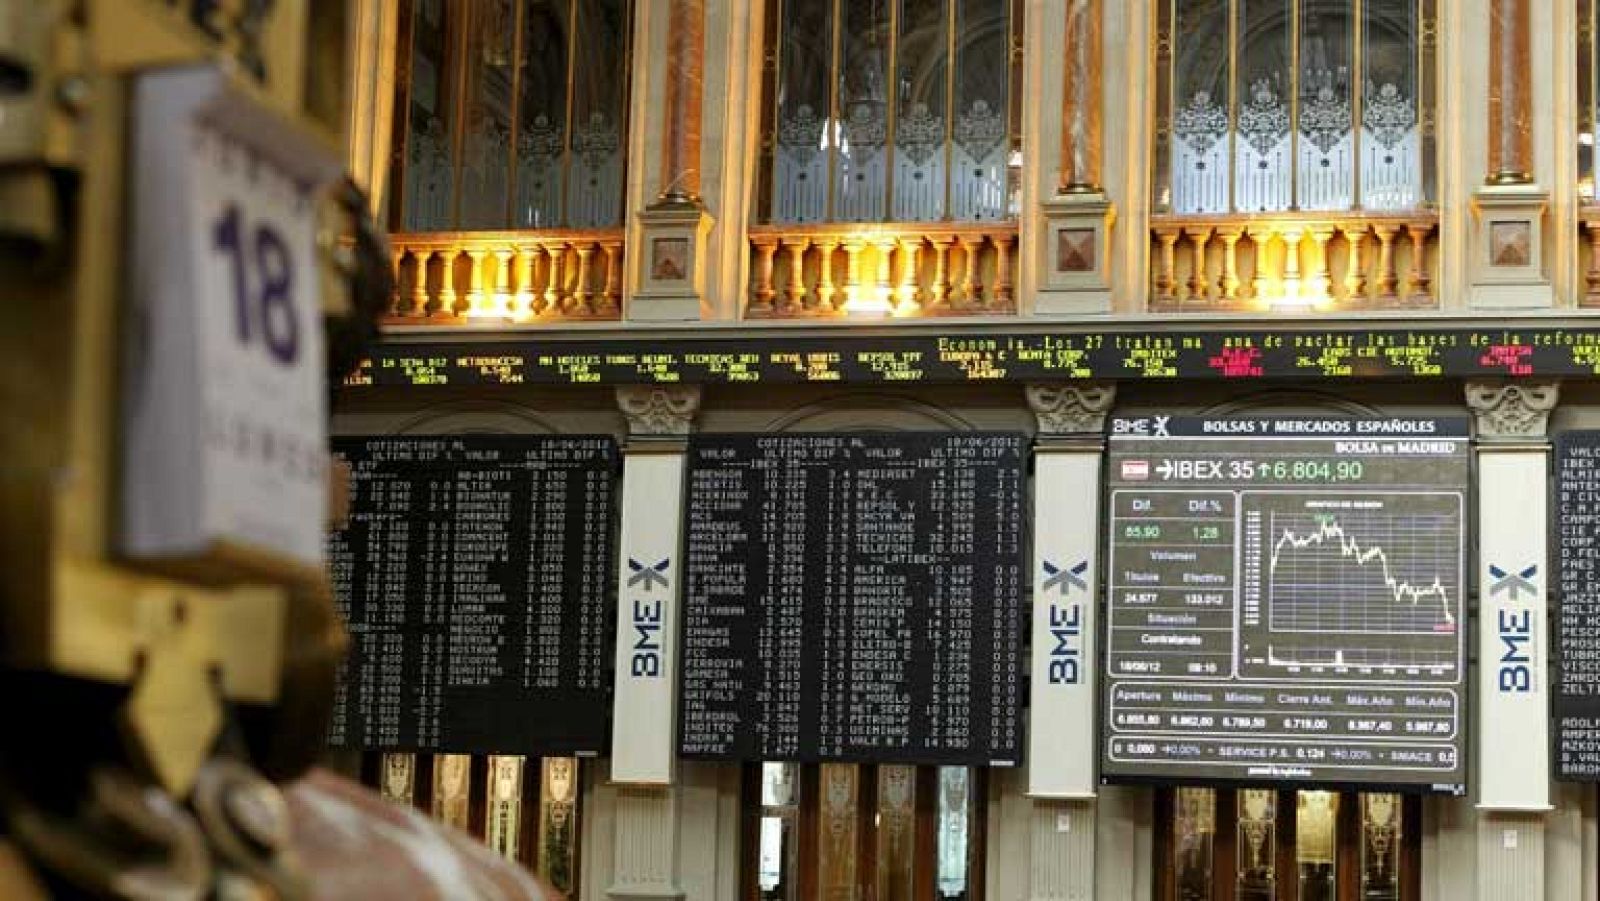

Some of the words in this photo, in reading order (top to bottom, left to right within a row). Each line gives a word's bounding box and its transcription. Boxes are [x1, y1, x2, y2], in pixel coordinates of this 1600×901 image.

[212, 205, 300, 370] 18
[1084, 335, 1103, 349] 27
[1408, 332, 1457, 347] bases
[1470, 333, 1489, 346] de
[1503, 332, 1520, 346] la
[1533, 331, 1600, 346] reform
[1203, 418, 1254, 432] BOLSAS
[1260, 419, 1270, 432] Y
[1274, 418, 1351, 432] MERCADOS
[1355, 416, 1436, 432] ESPAÑOLES
[1335, 441, 1378, 454] BOLSA
[1397, 441, 1456, 454] MADRID
[1174, 459, 1224, 479] IBEX
[1229, 459, 1255, 478] 35
[1273, 460, 1363, 482] 6.804,90
[1150, 550, 1197, 561] Volumen
[1141, 633, 1202, 646] Contratando
